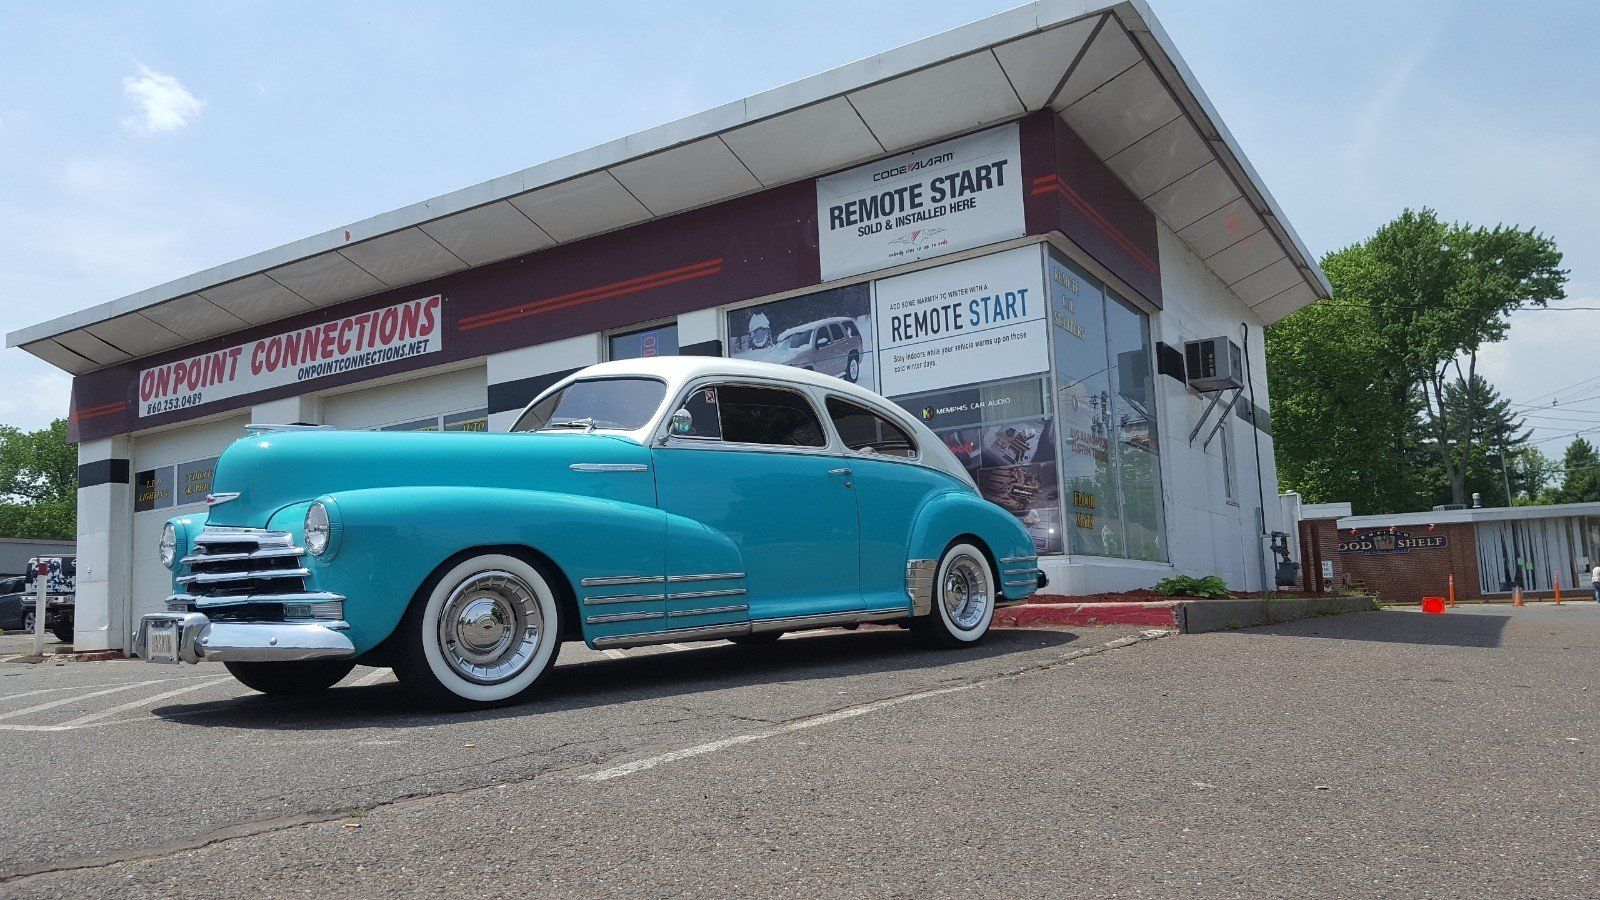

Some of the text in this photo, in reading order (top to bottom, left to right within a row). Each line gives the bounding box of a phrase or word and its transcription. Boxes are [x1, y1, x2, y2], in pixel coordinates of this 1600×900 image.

[829, 159, 1008, 231] REMOTE START
[858, 197, 977, 238] SOLD & INSTALLED HERE
[890, 303, 901, 311] ADD
[901, 300, 916, 309] SOME
[917, 293, 939, 305] WARMTH
[939, 292, 947, 300] TO
[947, 287, 969, 299] WINTER
[969, 284, 983, 294] WITH
[891, 288, 1028, 342] REMOTE START
[251, 296, 440, 376] CONNECTIONS
[893, 354, 905, 364] Stay
[905, 350, 926, 361] indoors
[926, 347, 941, 357] while
[941, 345, 953, 356] your
[954, 340, 974, 351] vehicle
[974, 337, 993, 347] warms
[993, 337, 1001, 345] up
[1010, 331, 1027, 341] those
[297, 339, 430, 380] ONPOINTCONNECTIONS.NET
[906, 360, 922, 371] winter
[923, 360, 938, 369] days.
[147, 392, 203, 414] 860.253.0489
[936, 404, 968, 415] MEMPHIS
[988, 397, 1011, 407] AUDIO
[1397, 537, 1443, 548] SHELF
